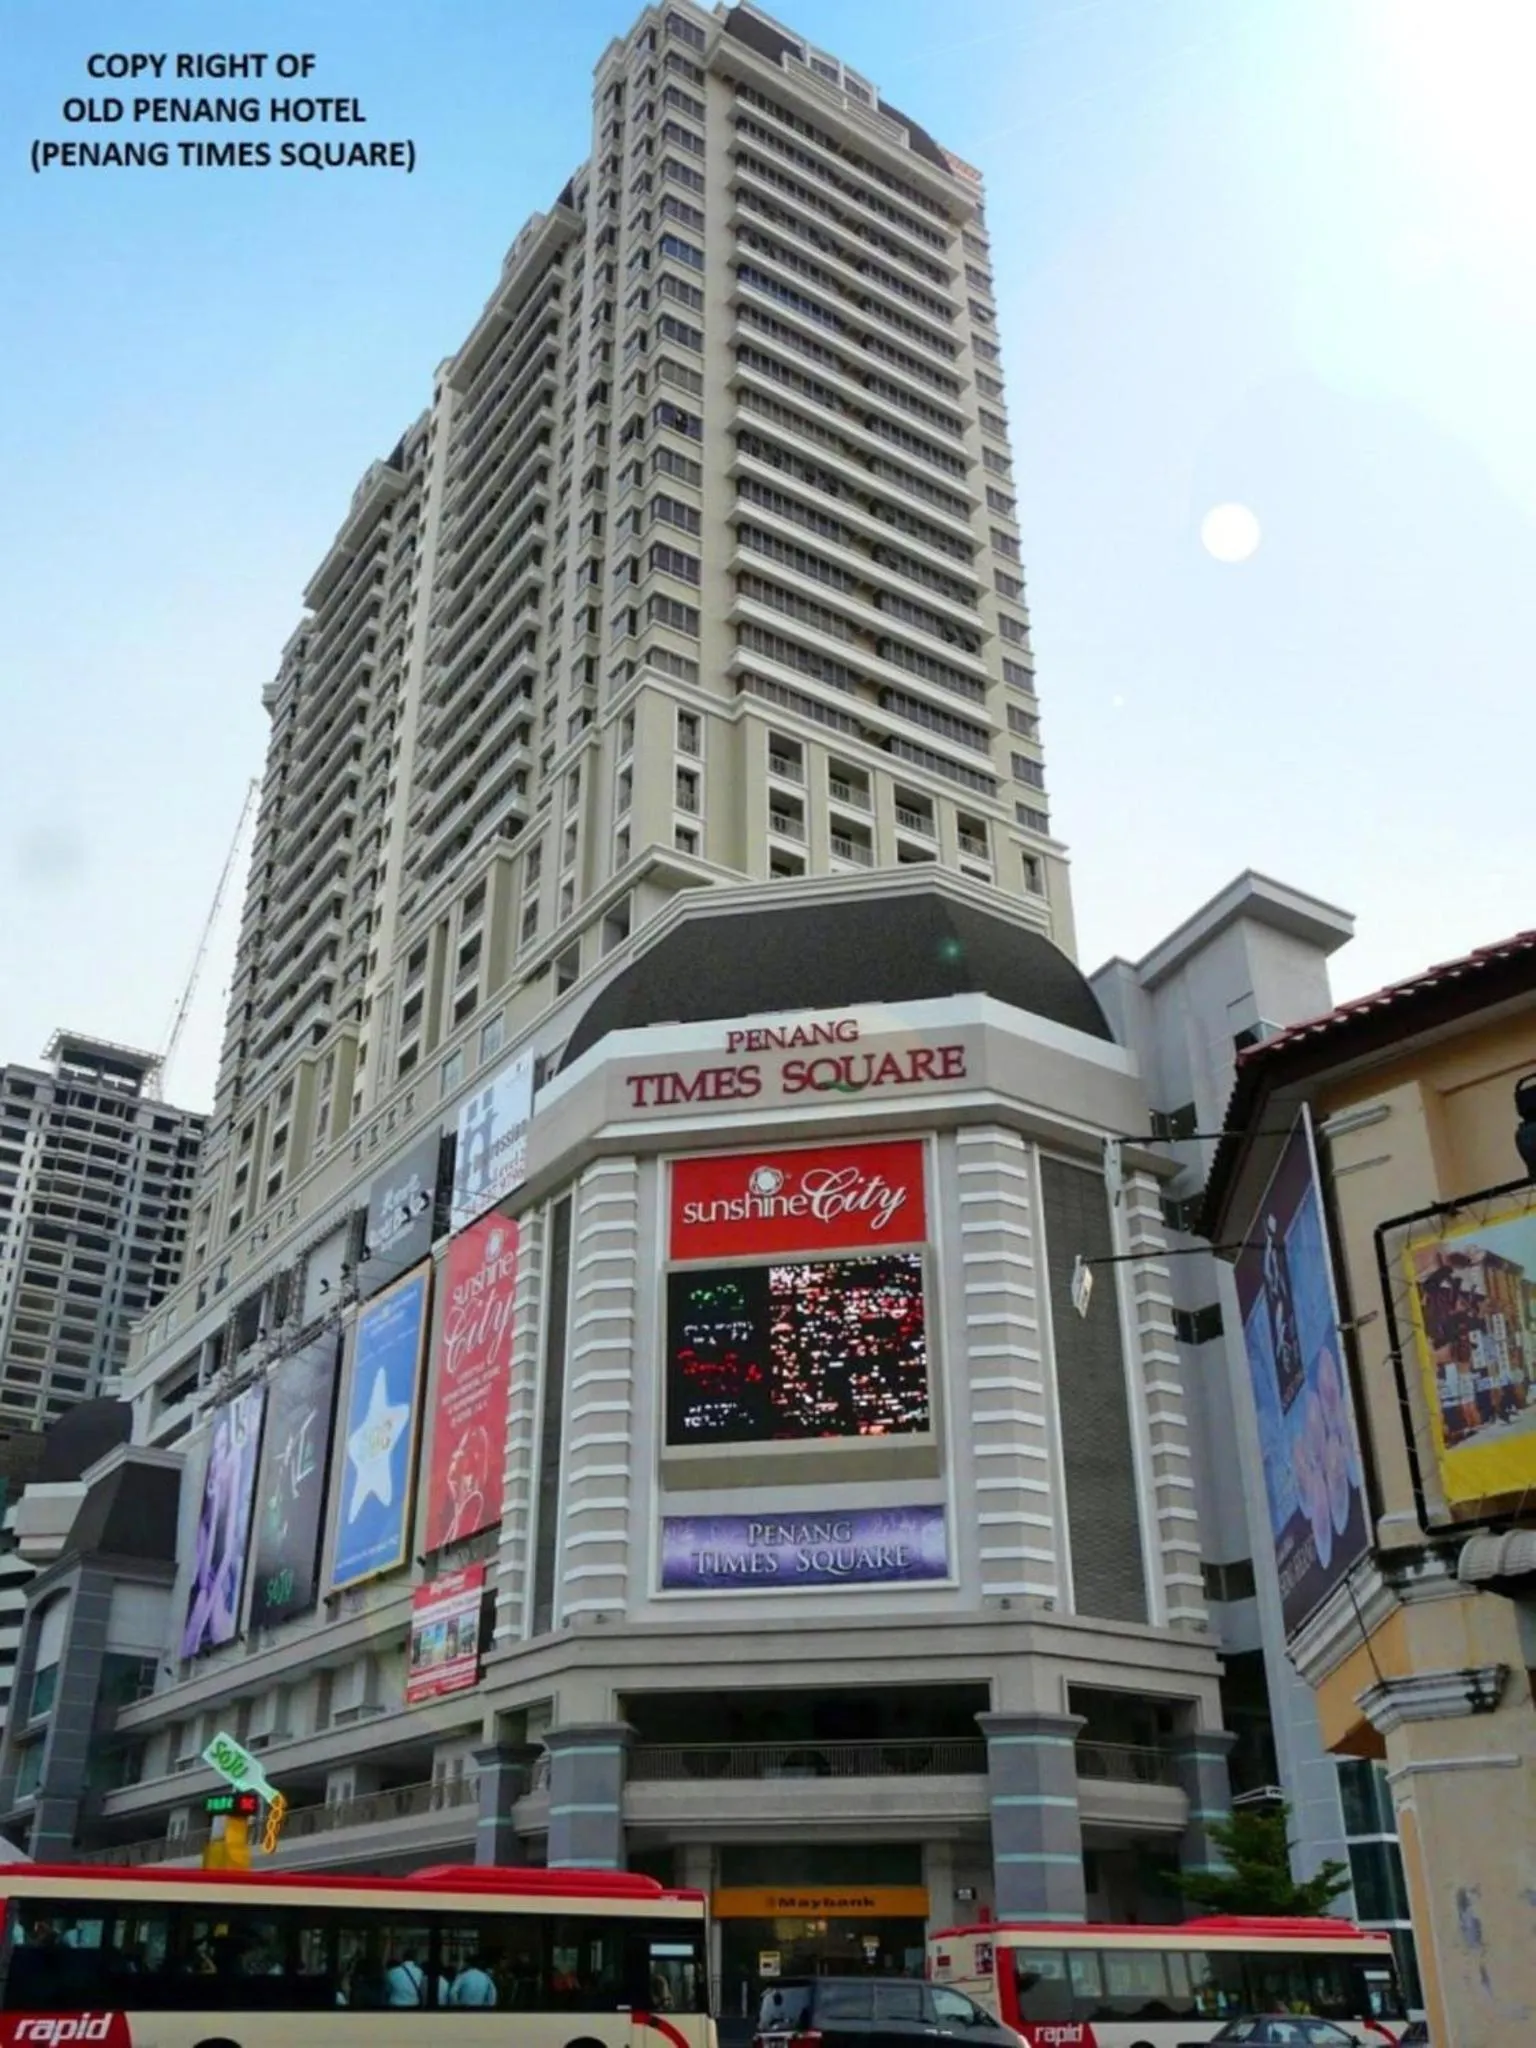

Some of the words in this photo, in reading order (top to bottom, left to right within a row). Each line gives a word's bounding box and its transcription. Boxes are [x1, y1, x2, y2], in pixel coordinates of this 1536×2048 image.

[726, 1019, 859, 1054] PENANG
[627, 1065, 761, 1107] TIMES
[782, 1044, 966, 1093] SQUARE
[452, 1250, 515, 1307] sunshine
[444, 1289, 513, 1374] City
[747, 1522, 853, 1546] PENANG
[692, 1551, 778, 1575] TIMES
[796, 1543, 909, 1576] SQUARE
[778, 1896, 875, 1909] Maybank
[14, 2011, 114, 2048] rapid
[1034, 2022, 1084, 2046] rapid
